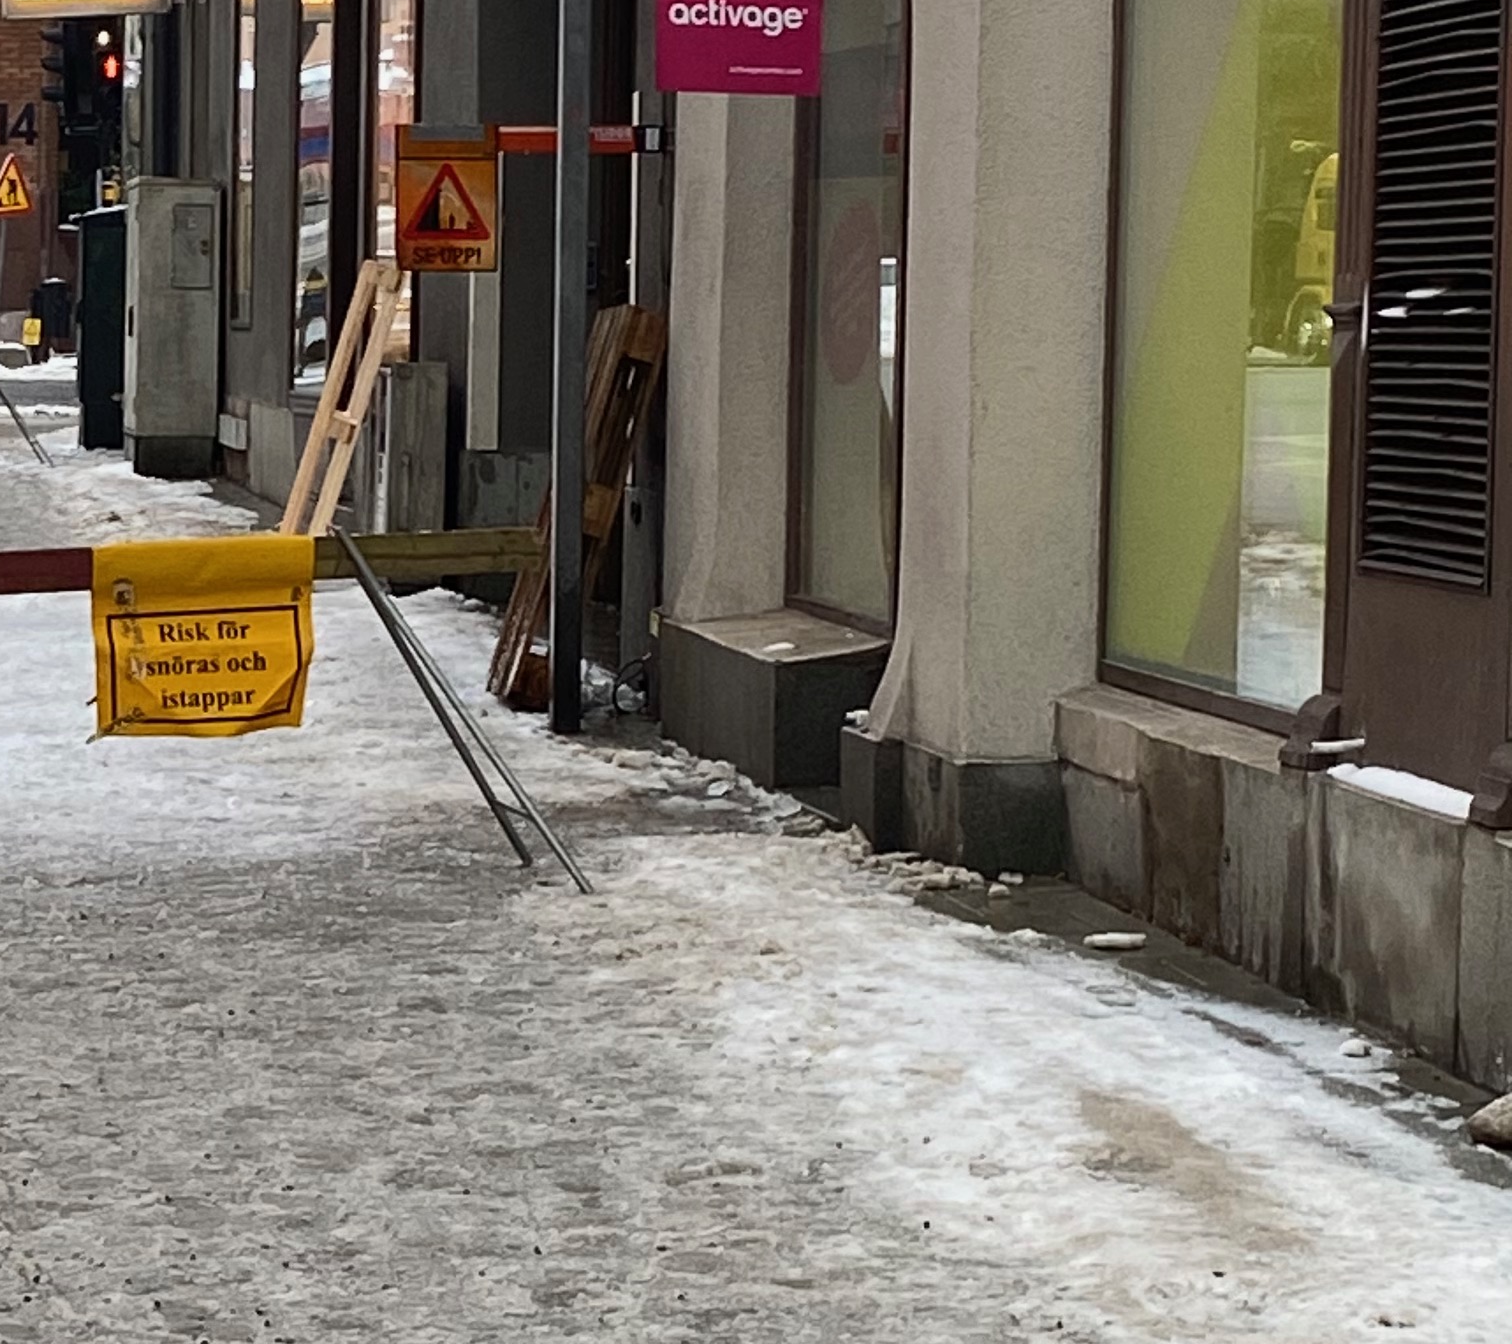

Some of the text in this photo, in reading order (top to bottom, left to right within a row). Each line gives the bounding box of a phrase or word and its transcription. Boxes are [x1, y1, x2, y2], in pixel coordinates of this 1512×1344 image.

[158, 620, 251, 643] Risk för
[145, 651, 267, 676] snöras och
[161, 688, 256, 713] istappar
